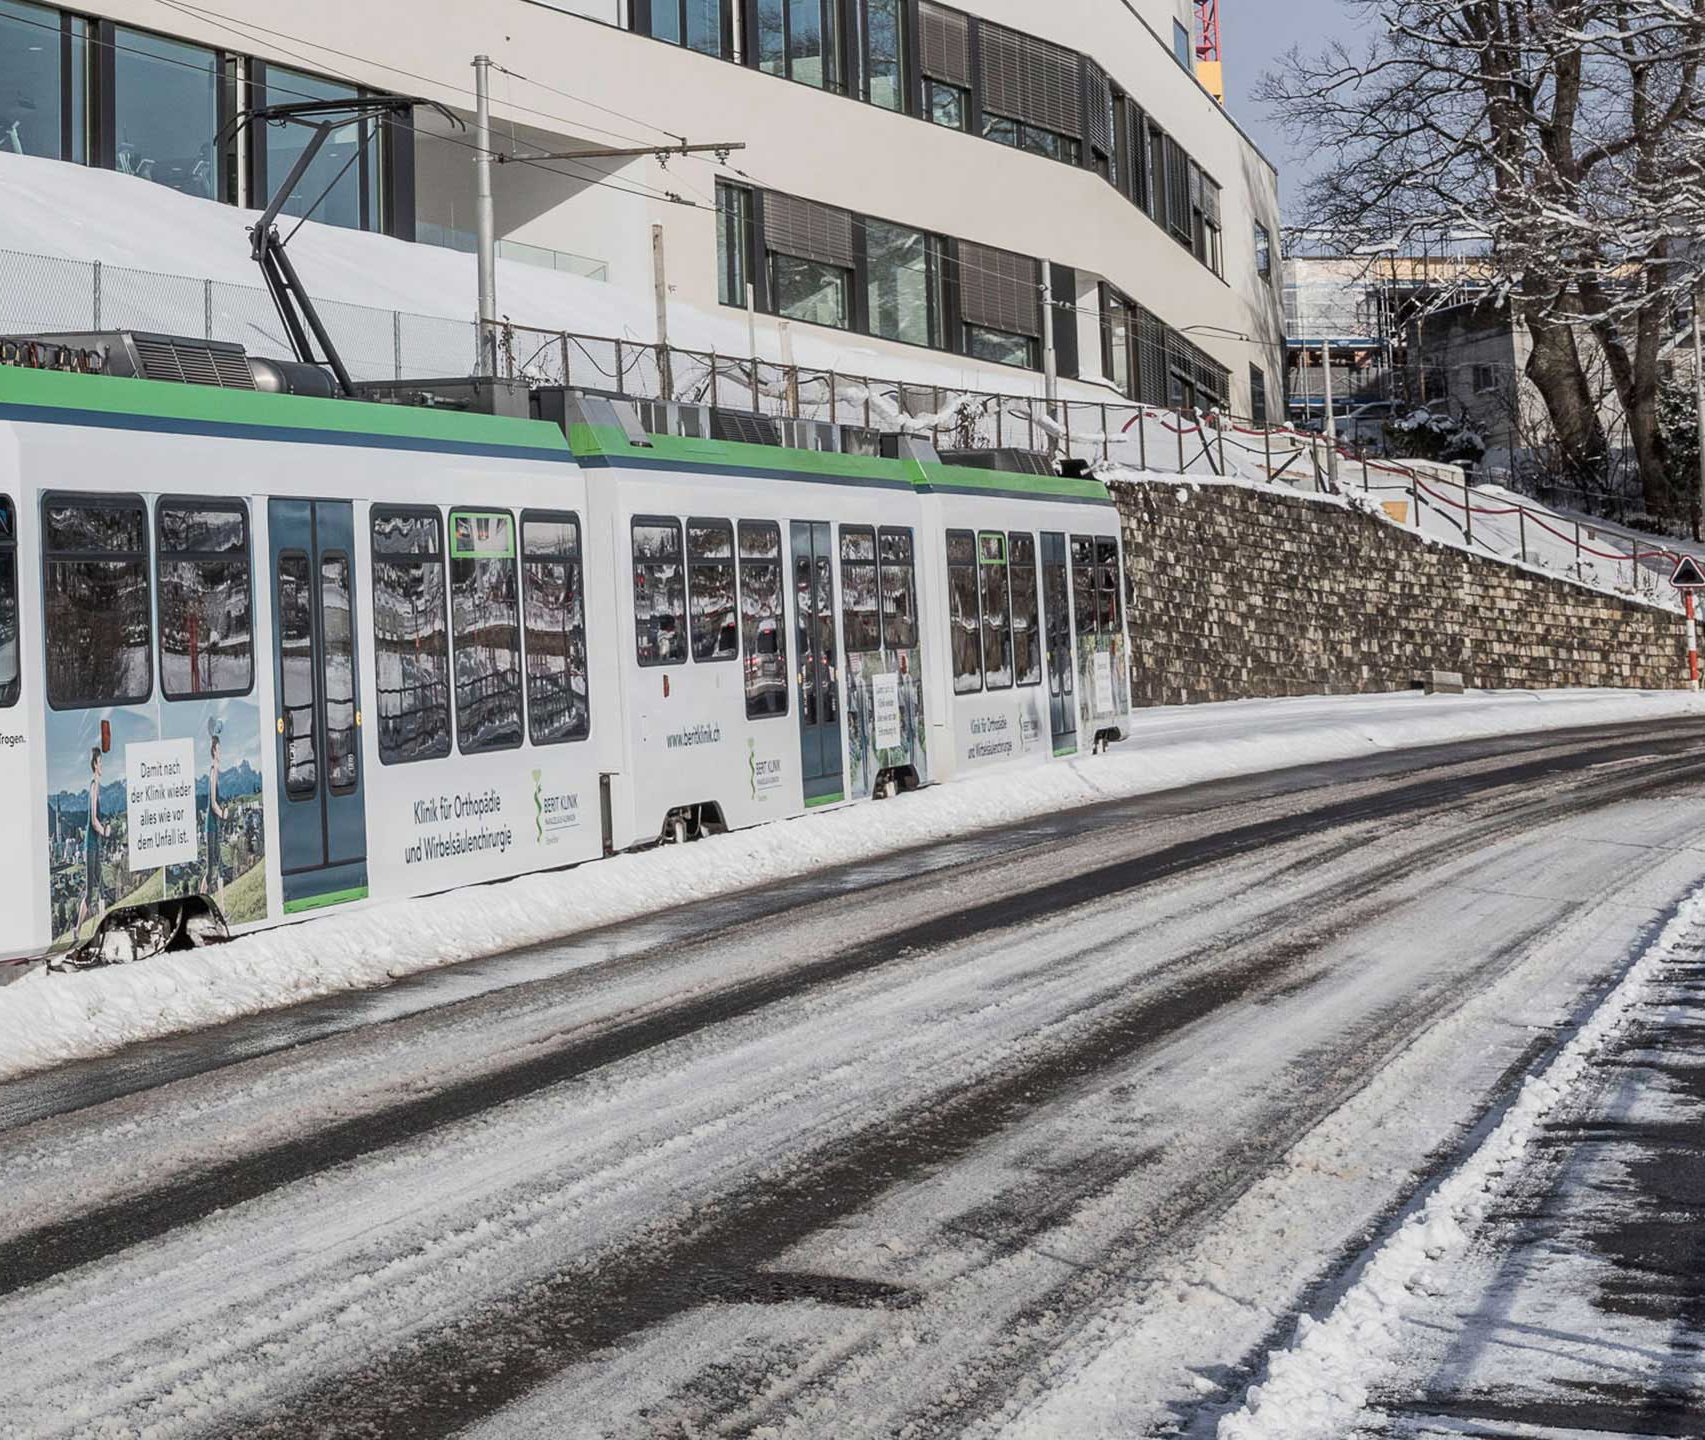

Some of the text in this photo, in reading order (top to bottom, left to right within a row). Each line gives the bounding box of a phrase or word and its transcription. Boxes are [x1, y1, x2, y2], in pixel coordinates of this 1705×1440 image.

[140, 758, 182, 779] Damit nach
[130, 779, 192, 804] der Klinik wieder
[140, 806, 184, 826] alles wie vor
[413, 786, 501, 825] Klinik für Orthopädie
[137, 832, 153, 850] dem
[153, 828, 176, 848] Unfall
[404, 823, 512, 864] und Wirbelsäulenchirurgie
